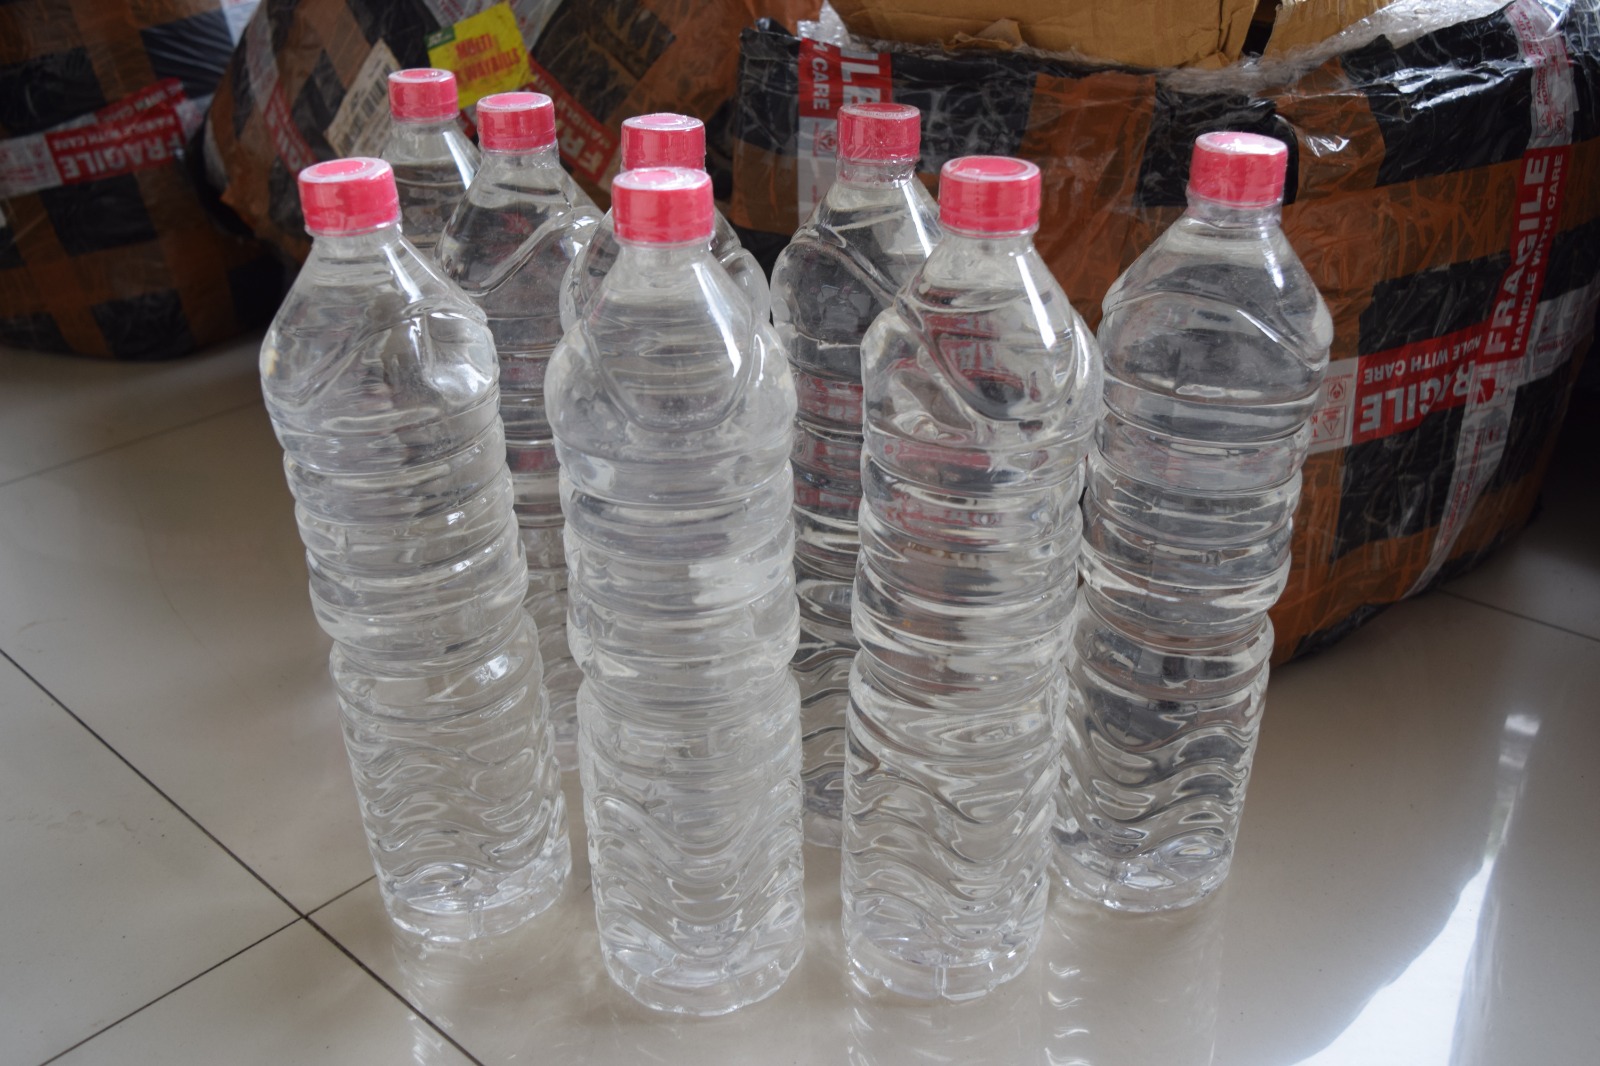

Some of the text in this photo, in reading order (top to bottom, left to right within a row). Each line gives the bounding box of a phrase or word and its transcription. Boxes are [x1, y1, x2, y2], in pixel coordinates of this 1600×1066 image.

[812, 57, 830, 110] CARE
[1484, 155, 1550, 356] FRAGILE
[1511, 153, 1564, 351] HANDLE WITH CARE
[1363, 359, 1407, 385] CARE
[1409, 348, 1449, 373] WITH
